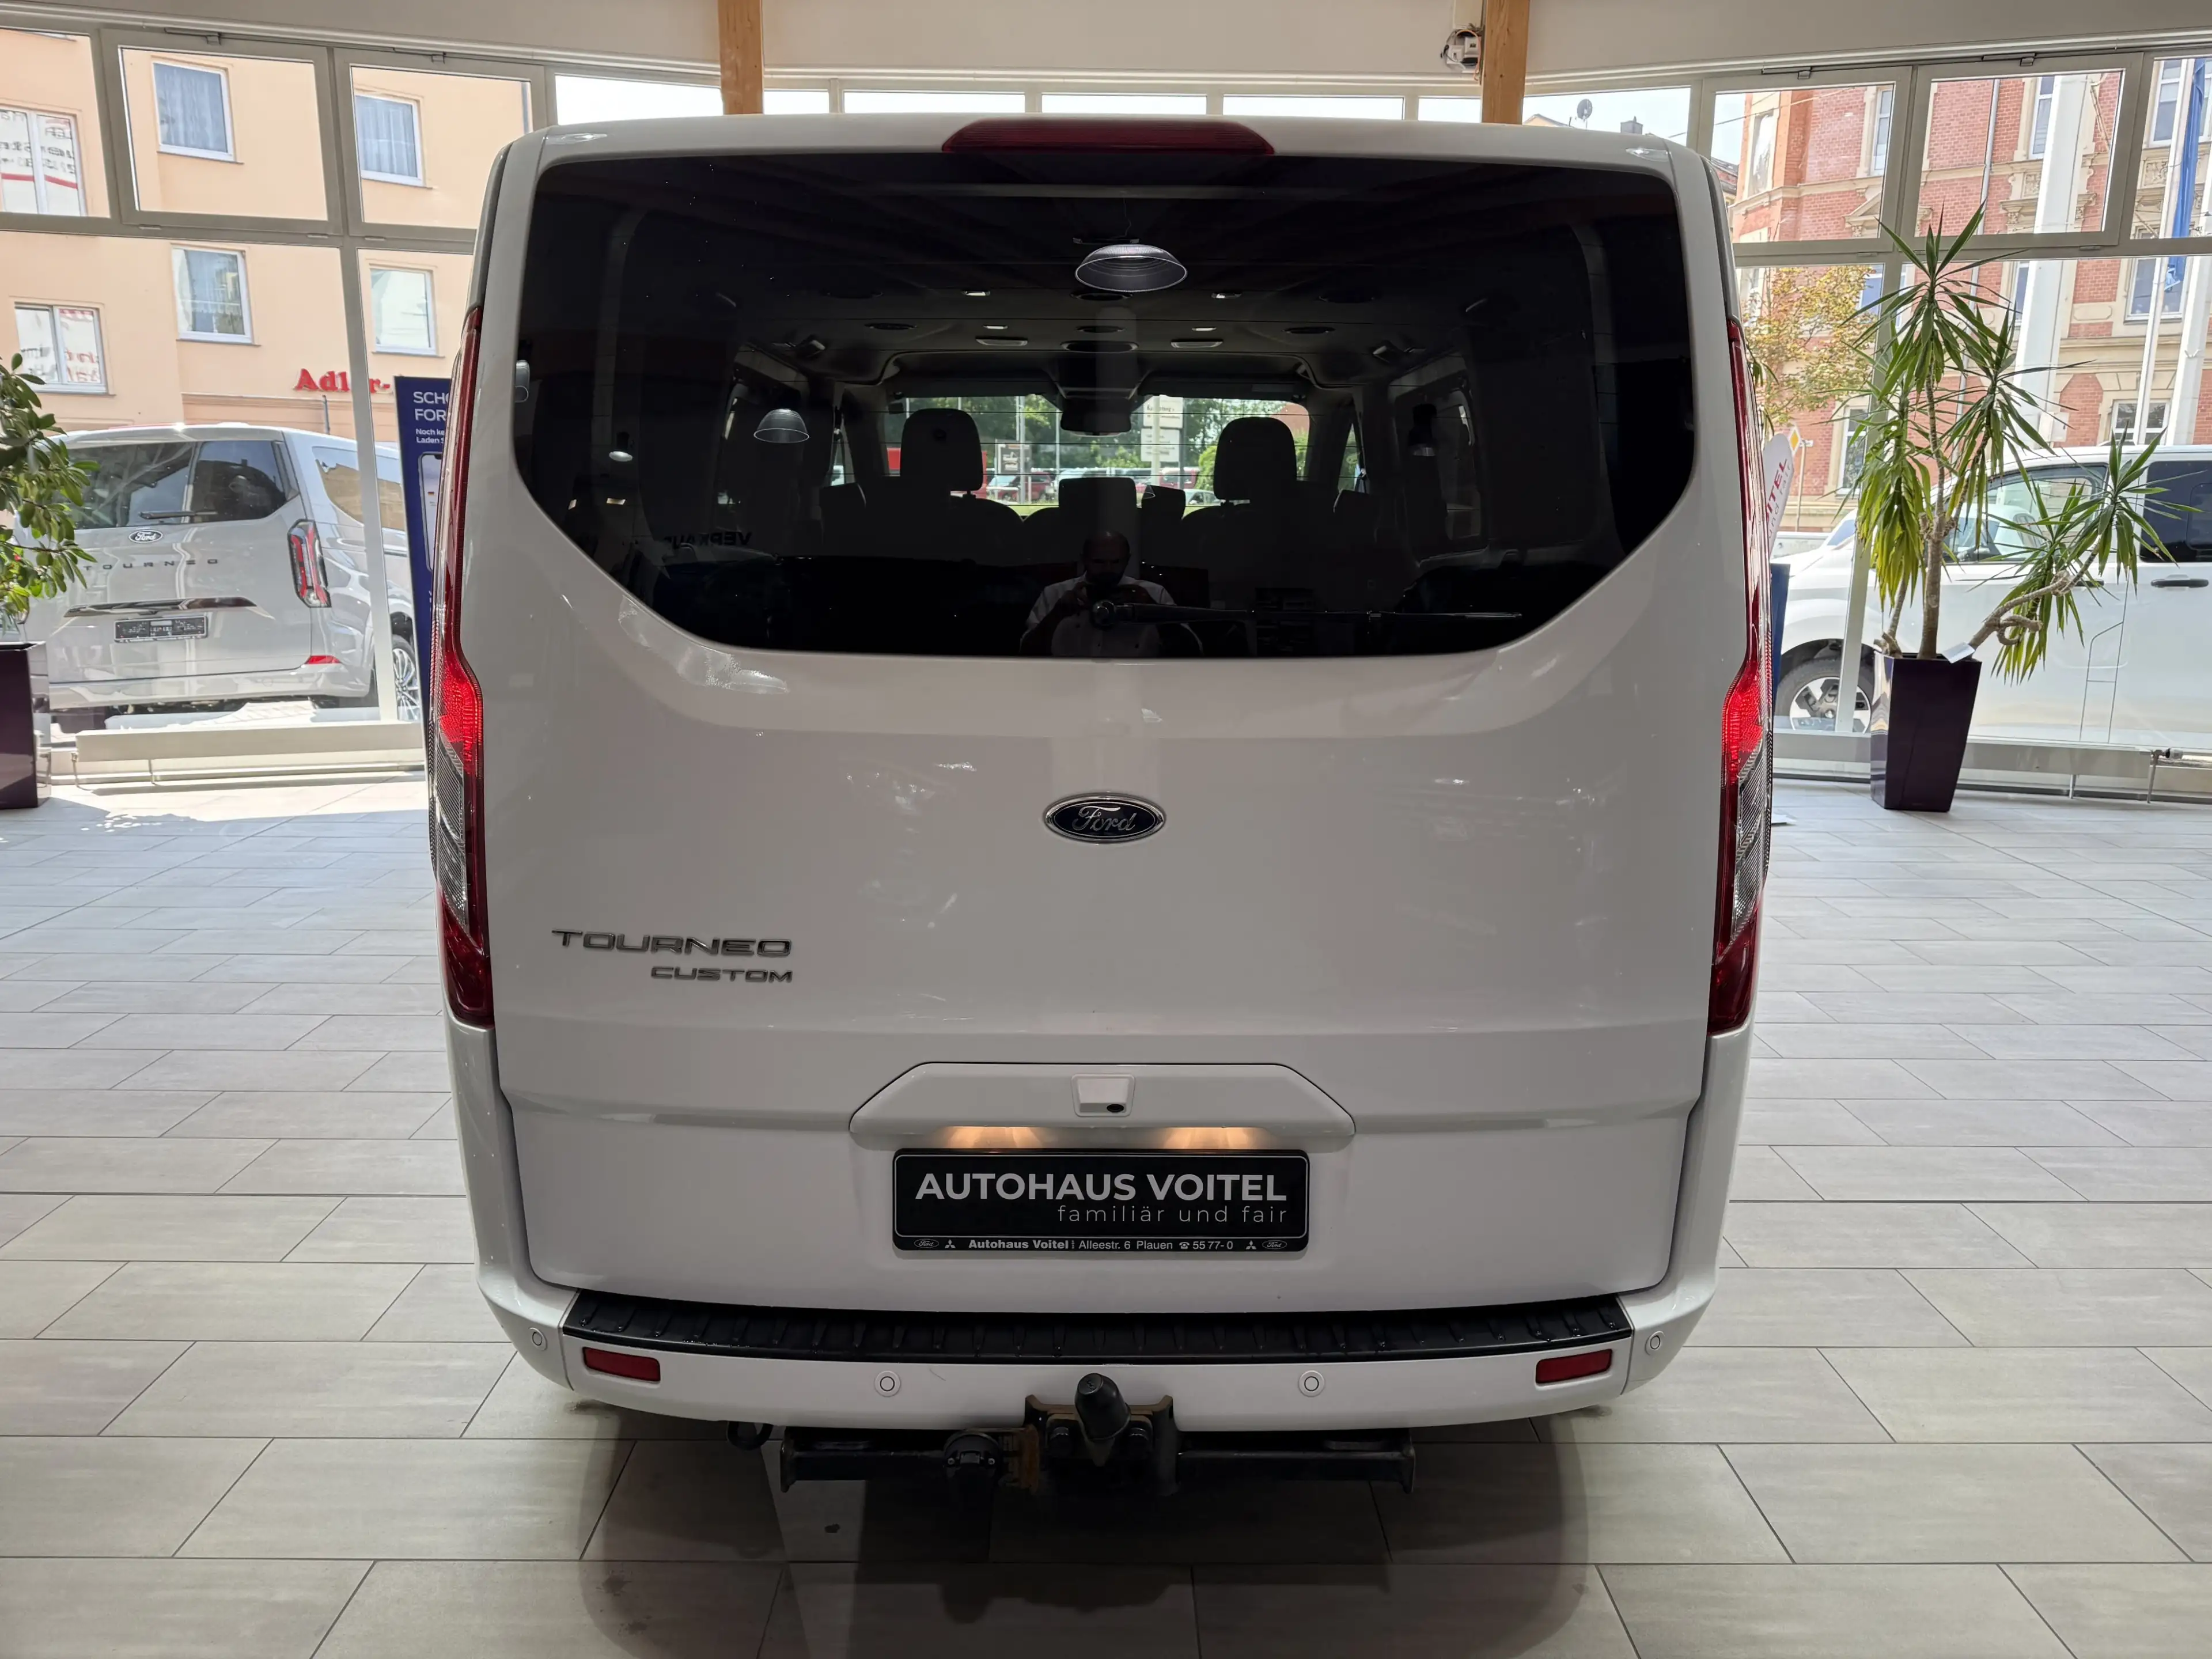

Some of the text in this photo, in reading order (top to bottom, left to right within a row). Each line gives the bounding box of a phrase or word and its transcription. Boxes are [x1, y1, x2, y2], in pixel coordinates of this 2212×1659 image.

[293, 368, 391, 393] Adlr-
[83, 558, 218, 571] TOURNEO
[1071, 805, 1137, 831] Ford
[551, 929, 792, 957] TOURNEO
[650, 965, 793, 983] CUSTOM
[915, 1173, 1287, 1202] AUTOHAUS VOITEL
[1058, 1205, 1287, 1222] familiär und fair
[968, 1239, 1029, 1249] Autohaus
[1033, 1240, 1069, 1249] Voitel
[1078, 1240, 1121, 1249] Alleestr.
[1124, 1241, 1131, 1249] 6
[1136, 1240, 1173, 1249] Plauen
